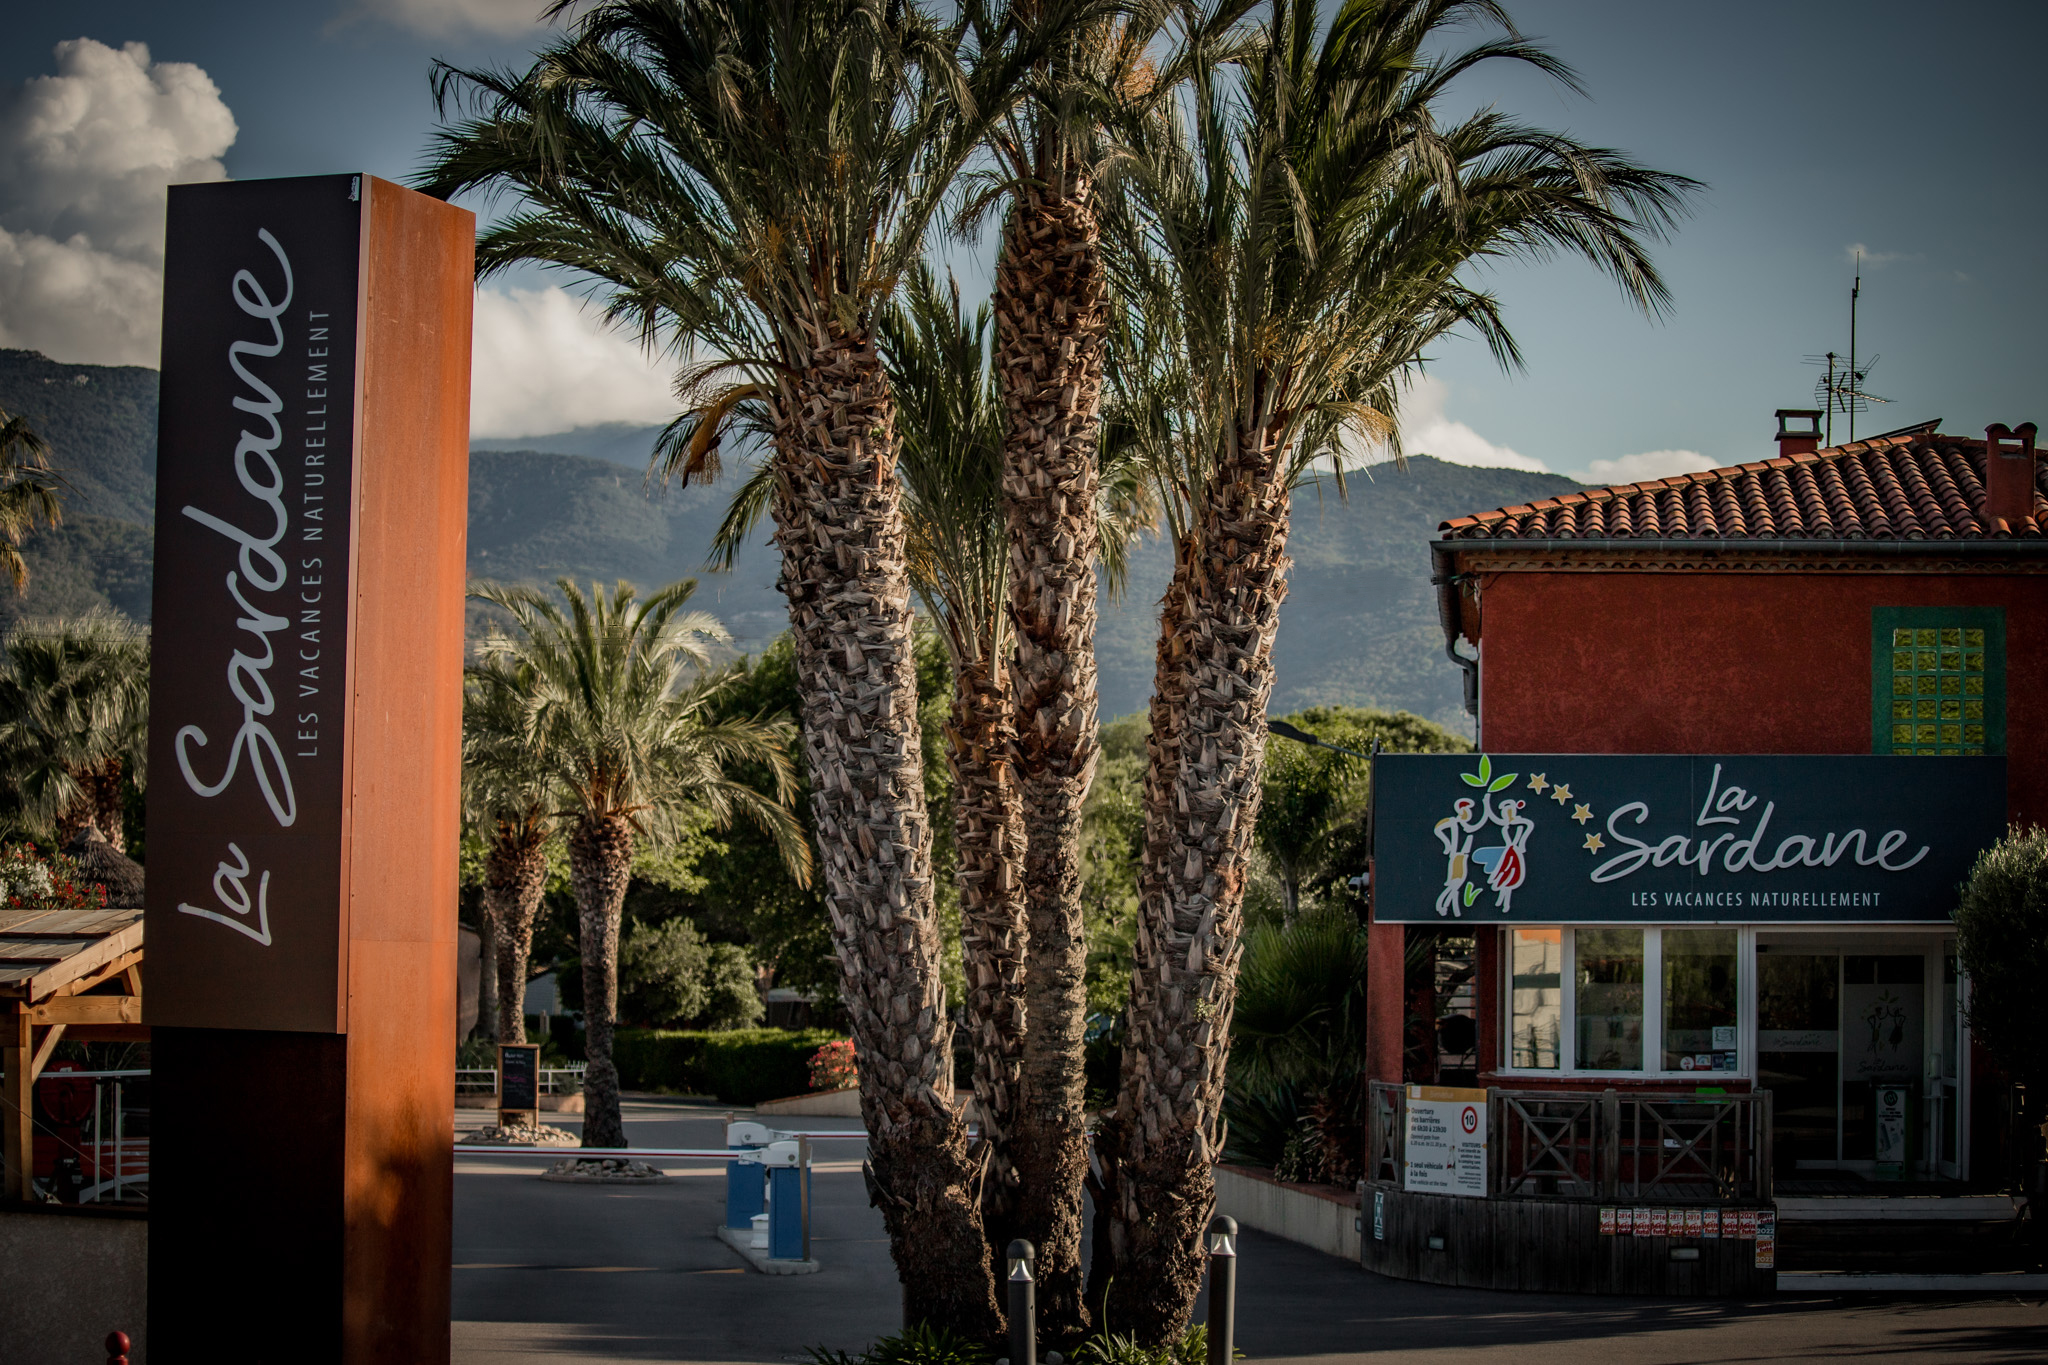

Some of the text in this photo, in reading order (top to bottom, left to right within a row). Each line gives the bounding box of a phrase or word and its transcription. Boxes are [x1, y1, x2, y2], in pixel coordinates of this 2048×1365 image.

[297, 311, 329, 757] LES VACANCES NATURELLEMENT
[175, 227, 297, 947] La Sardane
[1697, 763, 1758, 826] La
[1591, 801, 1930, 883] Sardane
[1632, 892, 1880, 907] LES VACANCES NATURELLEMENT
[1420, 1116, 1440, 1124] barrières
[1465, 1115, 1474, 1126] 10
[1424, 1162, 1443, 1170] véhicule
